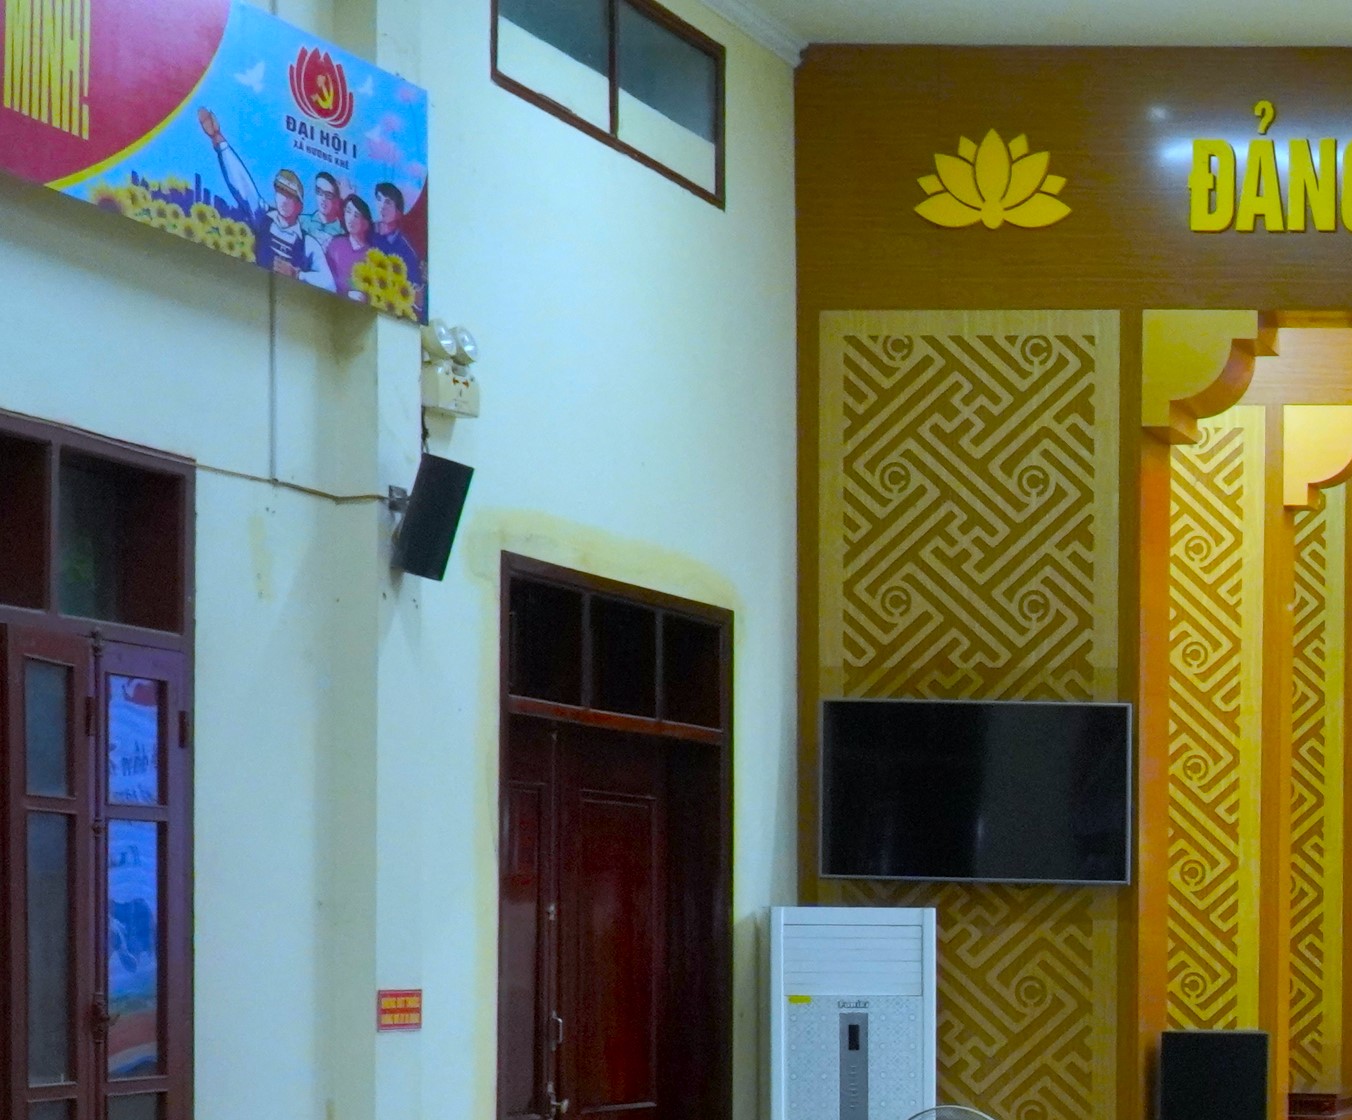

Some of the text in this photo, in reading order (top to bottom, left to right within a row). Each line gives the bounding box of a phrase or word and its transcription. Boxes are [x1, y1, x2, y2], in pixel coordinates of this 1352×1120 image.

[3, 0, 90, 140] MINH!
[286, 115, 314, 140] ĐẠI
[320, 130, 347, 155] HỘI
